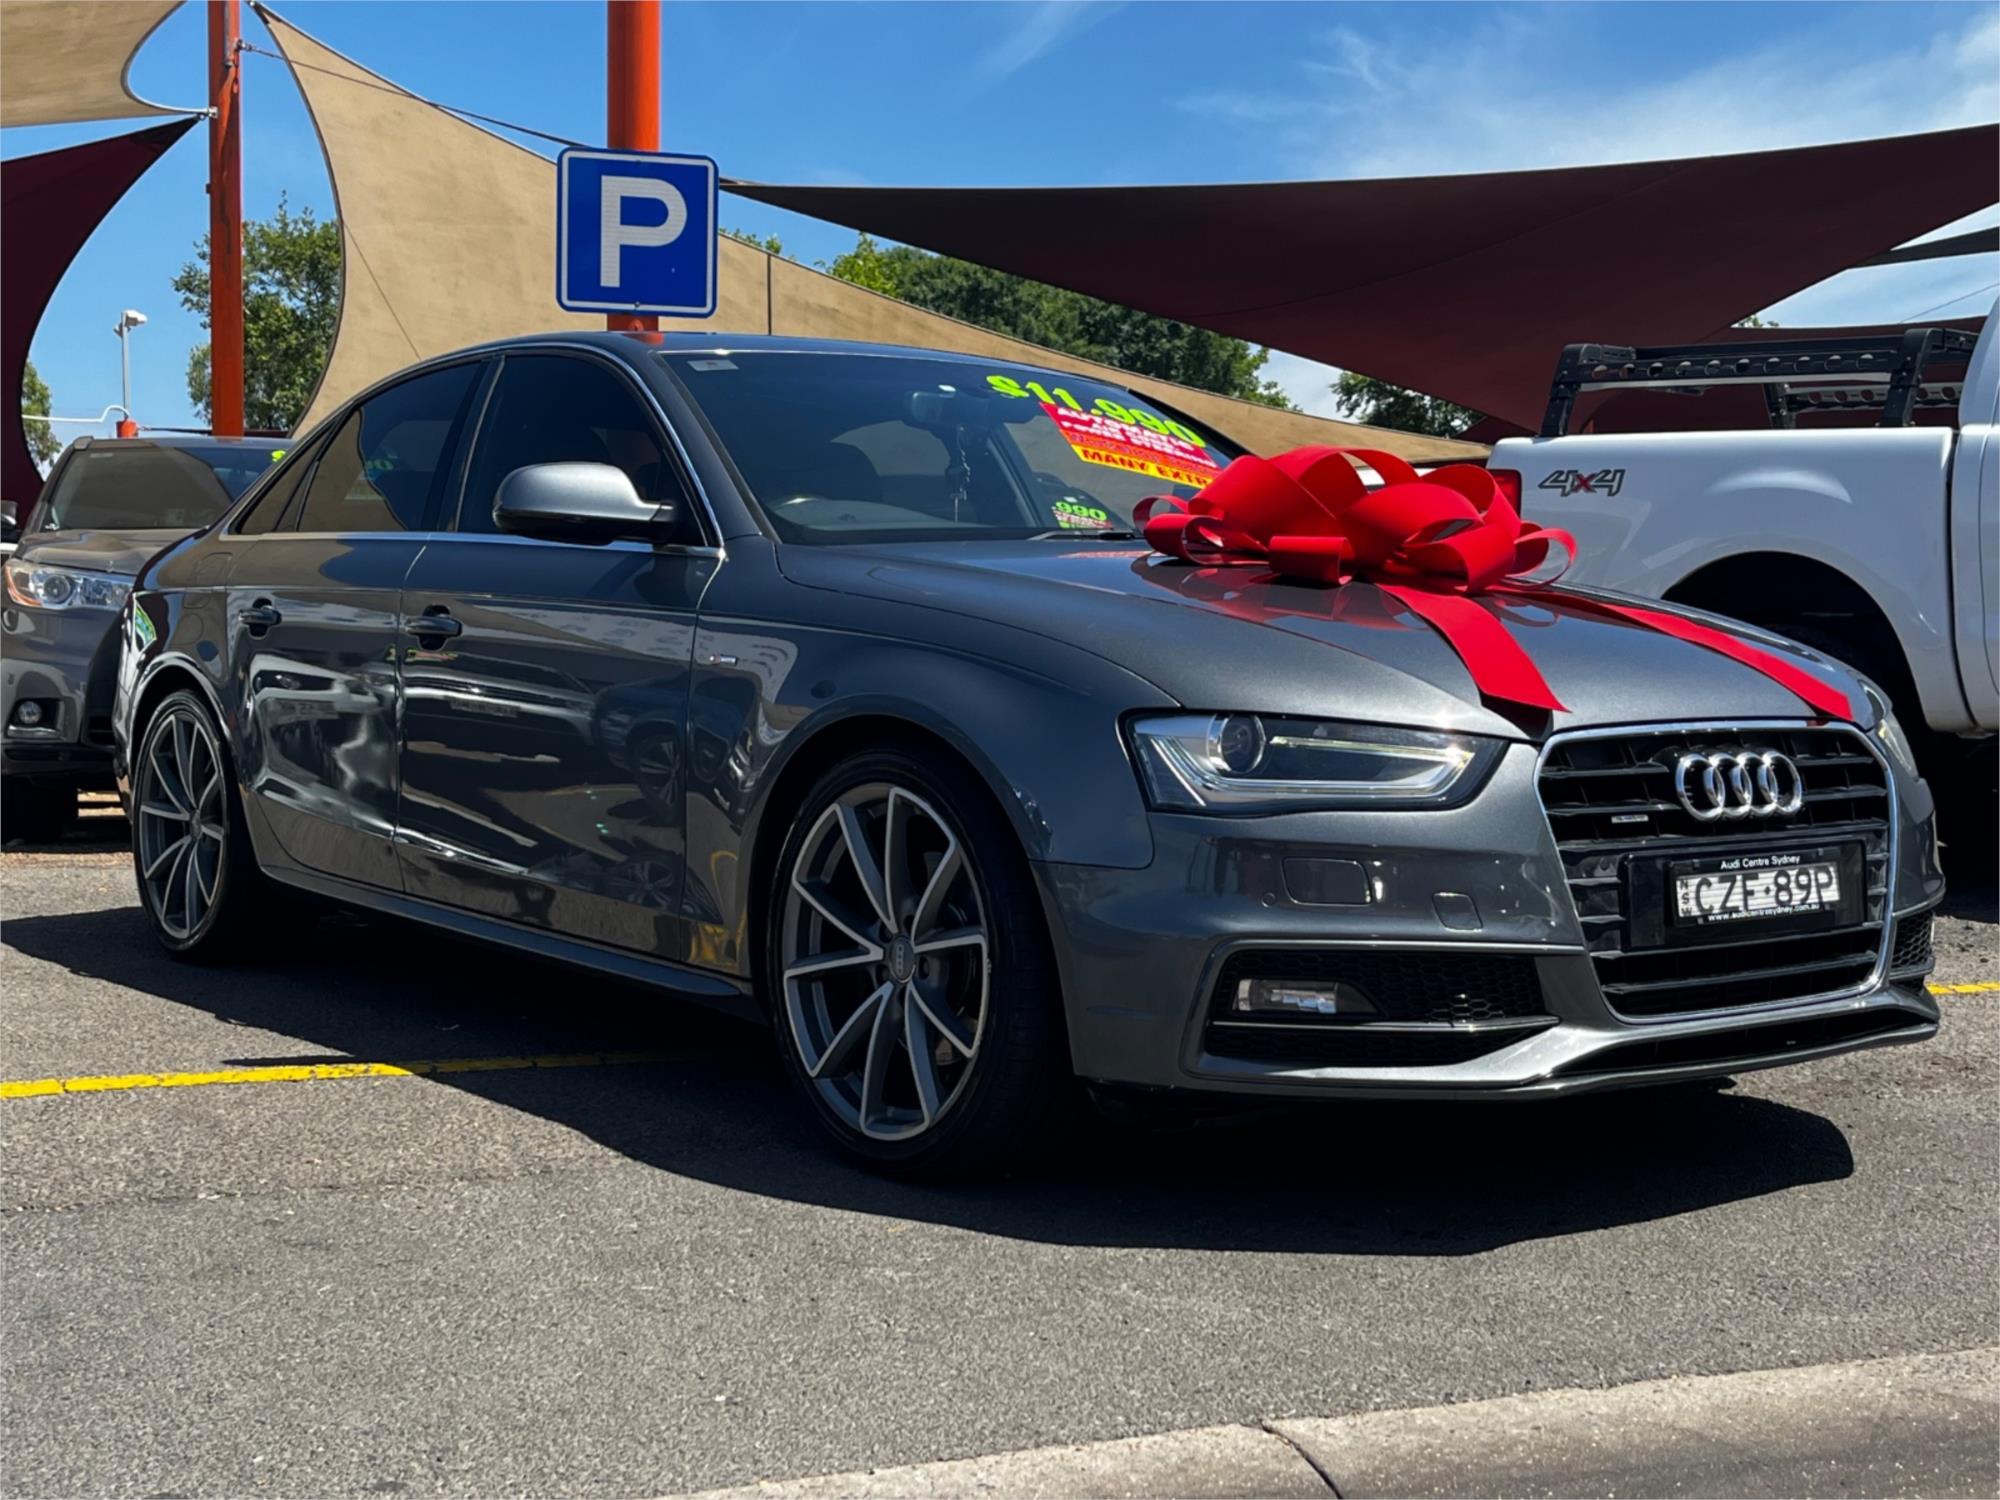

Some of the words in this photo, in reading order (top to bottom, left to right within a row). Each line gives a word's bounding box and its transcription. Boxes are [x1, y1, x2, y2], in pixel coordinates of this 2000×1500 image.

[600, 175, 688, 287] P
[1081, 449, 1147, 472] MANY
[1720, 860, 1741, 870] Audi
[1742, 857, 1769, 868] Centre
[1771, 855, 1800, 866] Sydney
